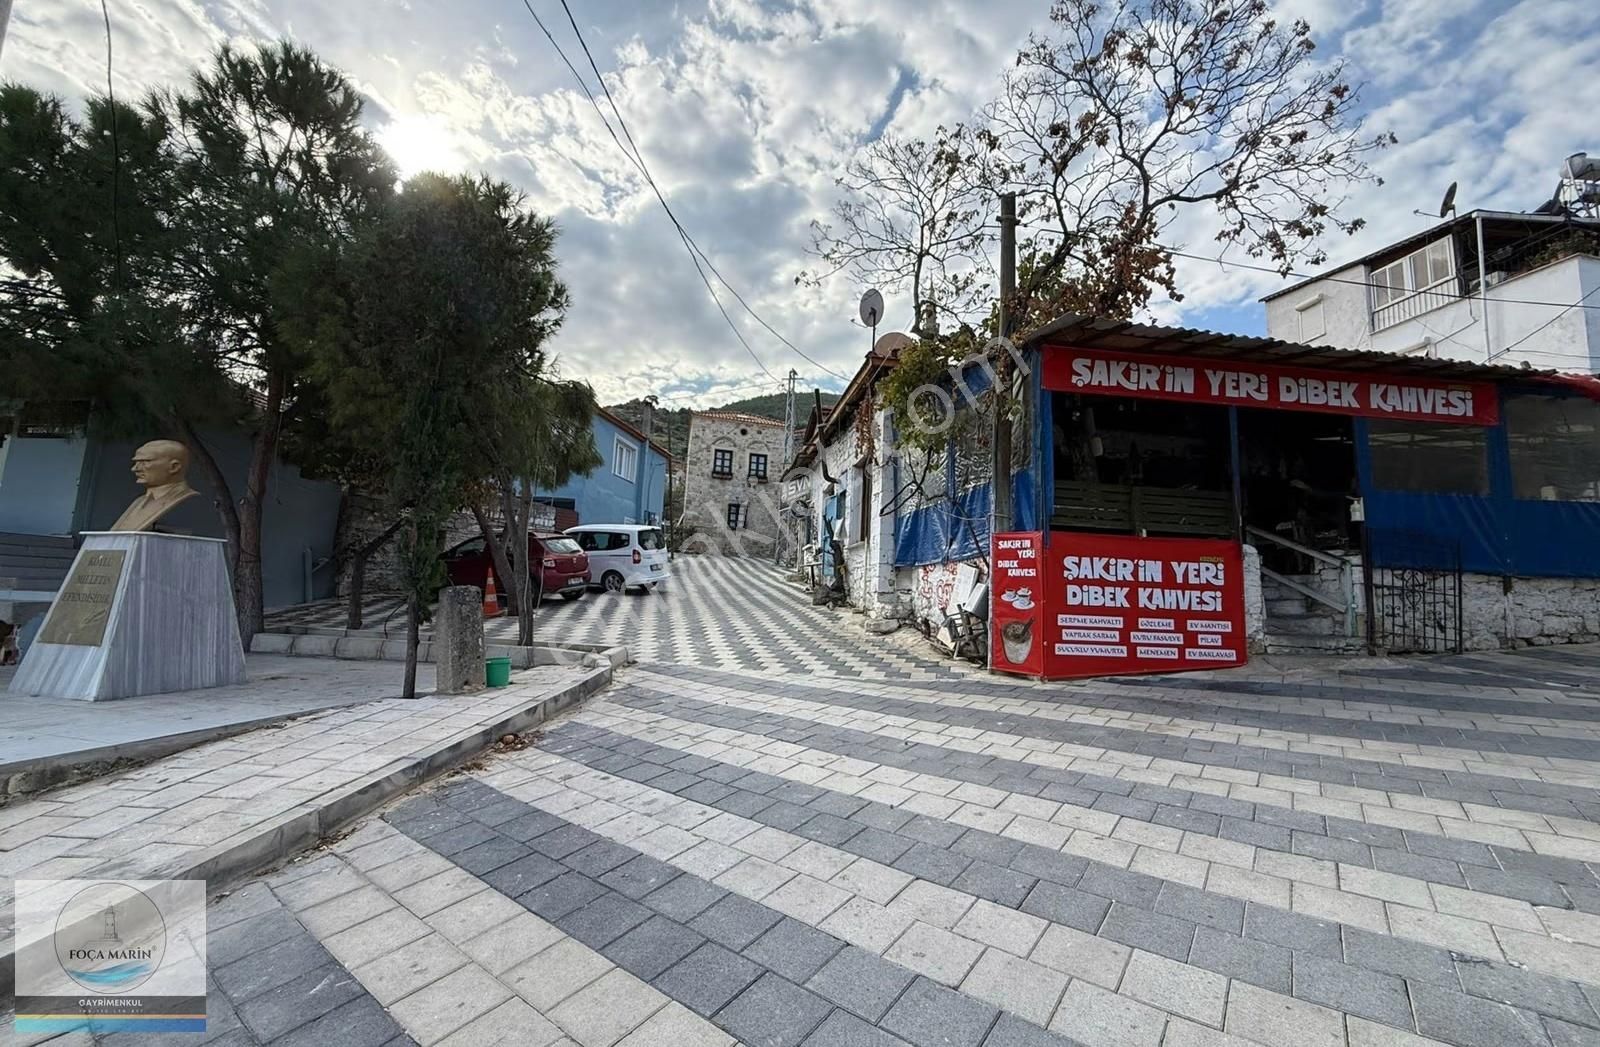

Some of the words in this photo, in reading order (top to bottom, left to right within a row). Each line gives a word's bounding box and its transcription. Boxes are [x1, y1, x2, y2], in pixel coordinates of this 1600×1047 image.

[1204, 369, 1269, 401] YERİ
[1279, 376, 1361, 409] DİBEK
[1369, 383, 1474, 417] KAHVESİ
[1170, 561, 1225, 586] YERİ
[1066, 585, 1131, 608] DİBEK
[1137, 589, 1223, 612] KAHVESİ
[1064, 631, 1091, 639] YAPRAK
[1090, 647, 1124, 655] YUMURTA
[1139, 649, 1176, 657] MENEMEN
